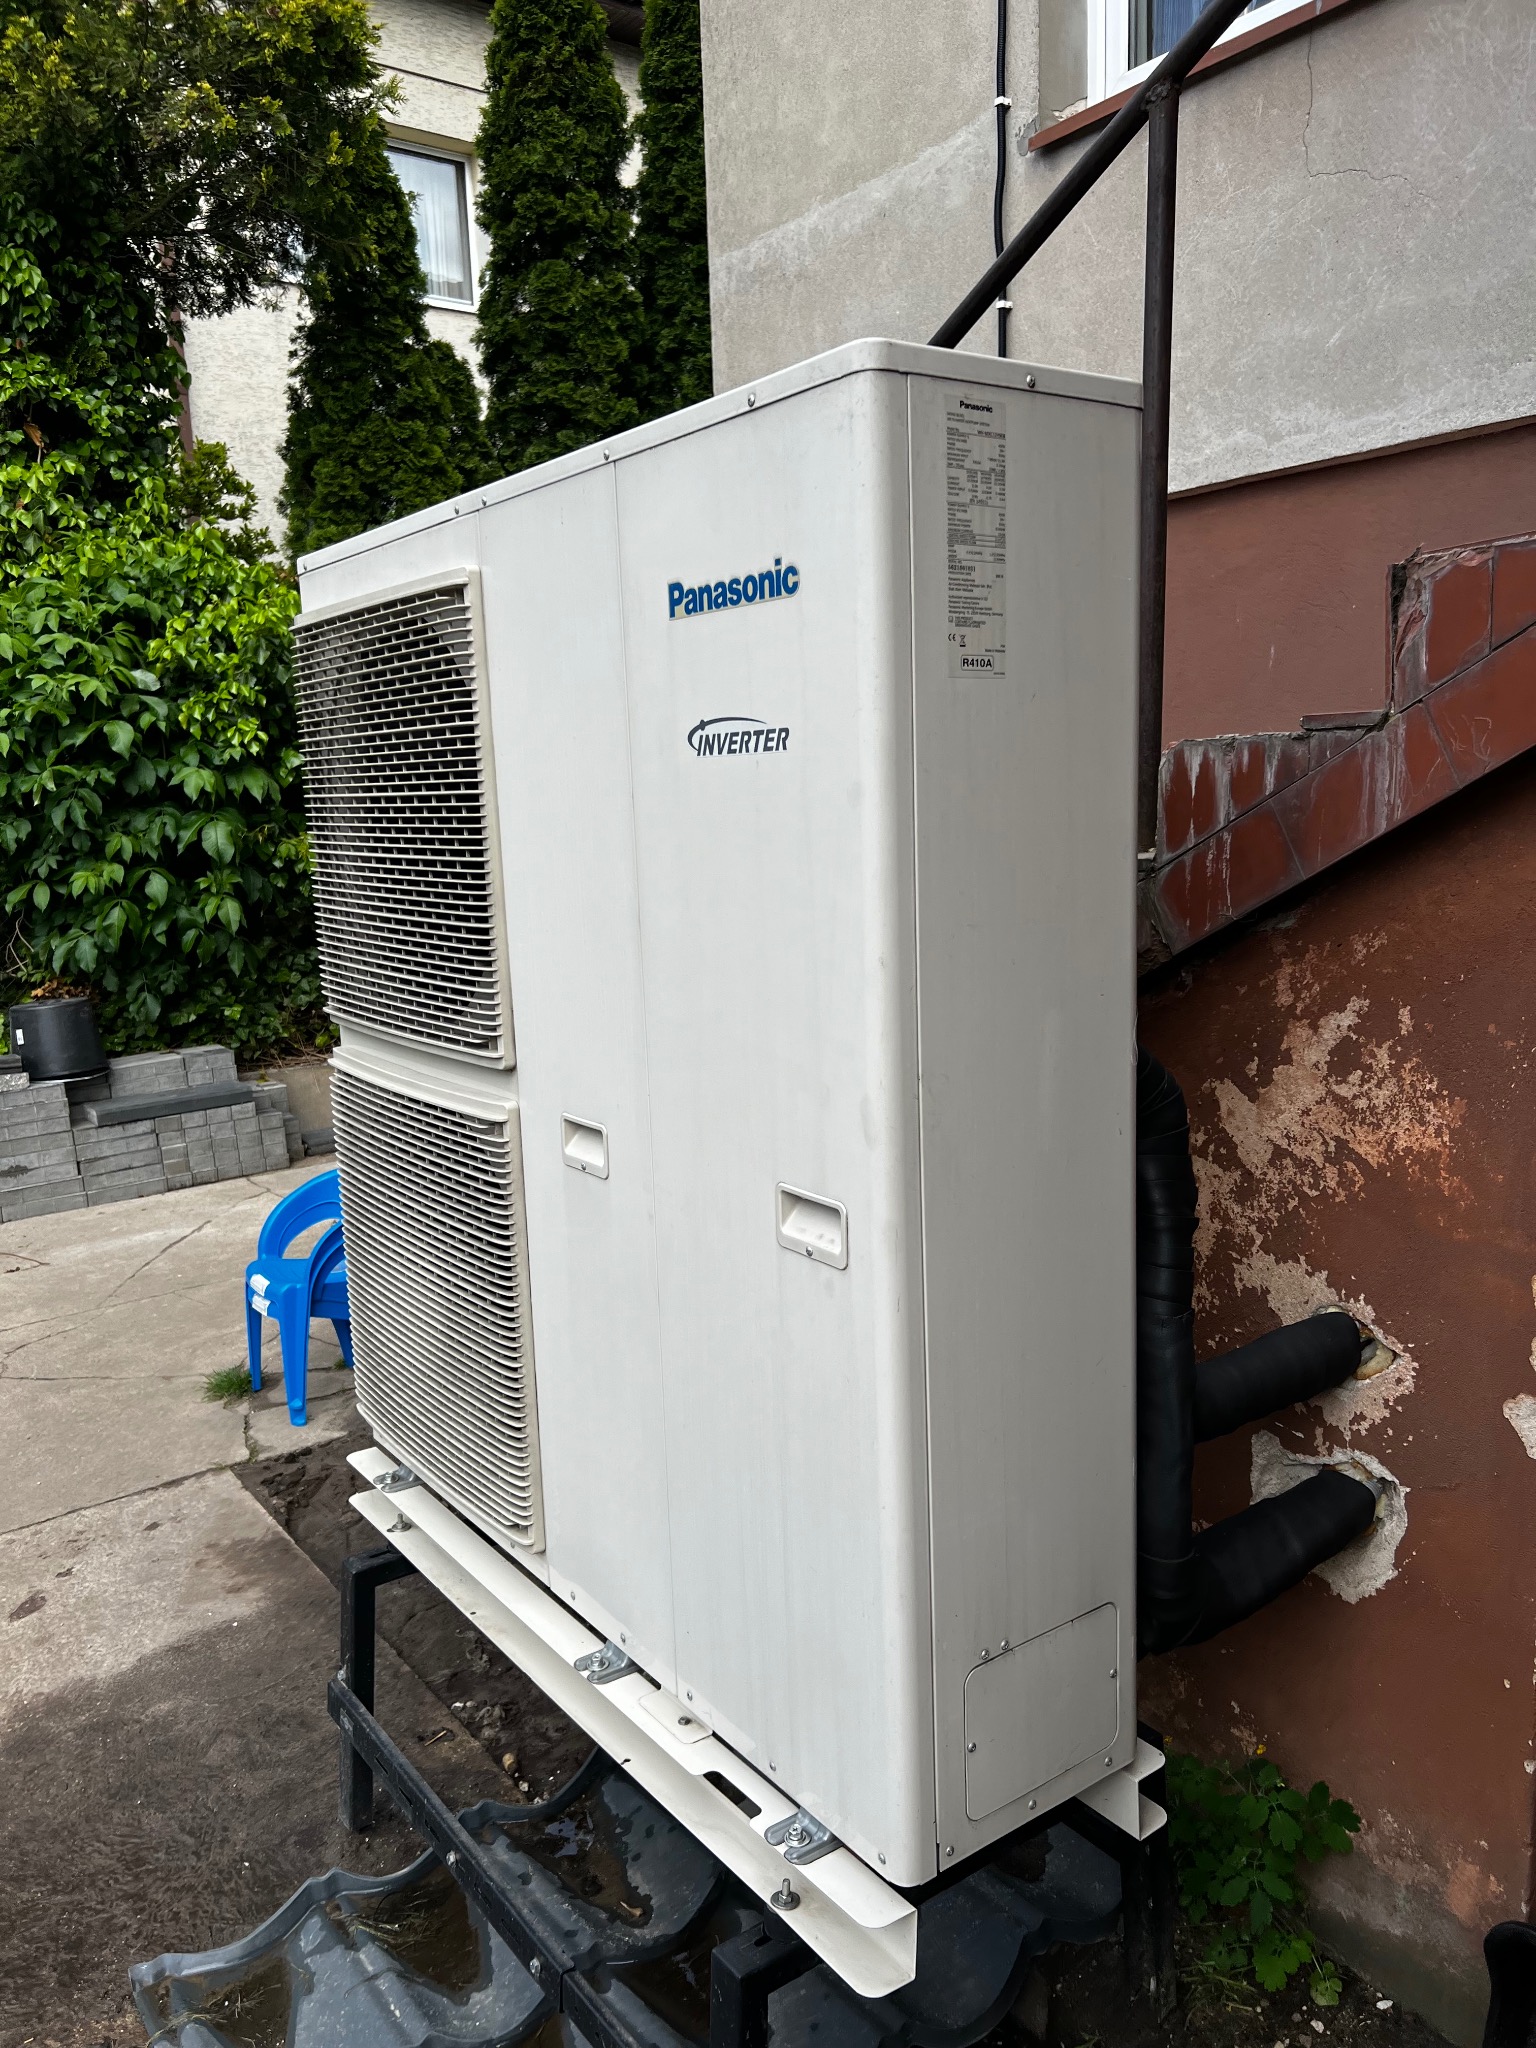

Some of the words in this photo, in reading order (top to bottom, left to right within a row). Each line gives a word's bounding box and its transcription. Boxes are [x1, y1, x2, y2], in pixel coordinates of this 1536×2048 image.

[959, 400, 993, 414] Panasonic
[668, 557, 799, 618] Panasonic
[962, 658, 993, 668] R410A
[696, 727, 790, 757] INVERTER
